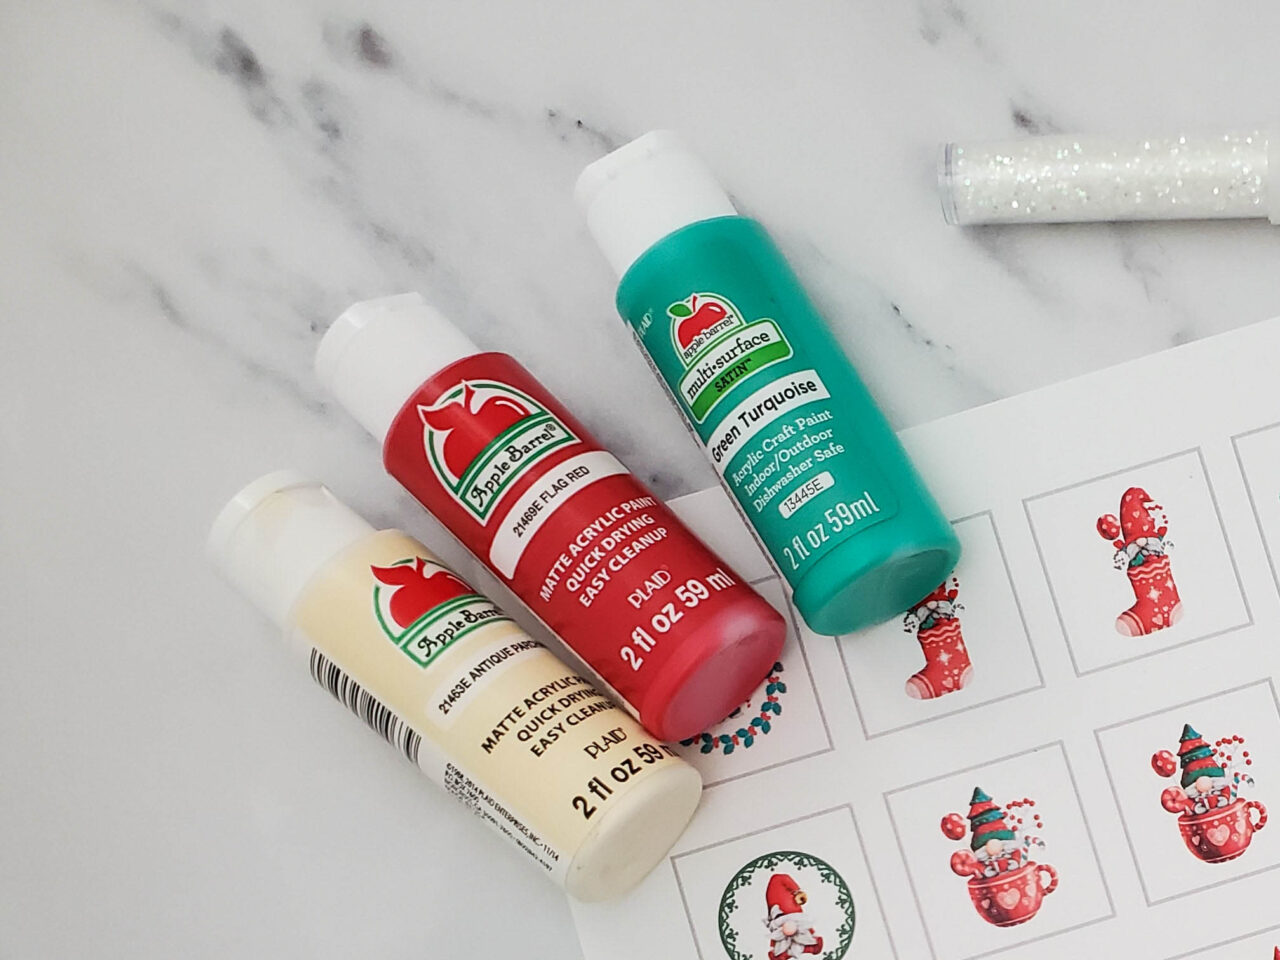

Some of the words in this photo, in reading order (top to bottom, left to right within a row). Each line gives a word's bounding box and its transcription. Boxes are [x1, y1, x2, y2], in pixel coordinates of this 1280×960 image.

[683, 337, 704, 360] apple
[703, 314, 734, 340] barrel
[712, 426, 742, 463] Green
[738, 380, 818, 429] Turquoise
[732, 447, 765, 487] Acrylic
[761, 424, 796, 452] Craft
[795, 409, 834, 431] Paint
[744, 428, 834, 497] Indoor/Outdoor
[470, 461, 511, 508] Apple
[753, 456, 814, 513] Dishwasher
[814, 442, 846, 463] Safe
[783, 477, 825, 513] 13445E
[512, 500, 544, 538] 21469E
[539, 479, 569, 505] FLAG
[565, 465, 591, 483] RED
[539, 553, 573, 602] MATTE
[567, 506, 625, 557] ACRYLIC
[620, 496, 658, 515] PAINT
[565, 546, 607, 592] QUICK
[600, 513, 656, 552] DRYING
[791, 535, 811, 561] fl
[806, 522, 830, 548] oz
[578, 569, 612, 608] EASY
[607, 527, 669, 573] CLEANUP
[783, 546, 800, 570] 2
[626, 569, 672, 609] PLAID
[673, 578, 711, 609] 59
[704, 567, 738, 592] ml
[417, 618, 466, 658] Apple
[650, 602, 685, 634] oz
[619, 645, 645, 671] 2
[631, 626, 657, 653] fl
[437, 676, 472, 715] 21463E
[470, 646, 514, 682] ANTIQUE
[480, 706, 526, 755] MATTE
[523, 676, 577, 710] ACRYLIC
[516, 704, 562, 743] QUICK
[530, 722, 567, 758] EASY
[583, 727, 629, 760] PLAID
[572, 795, 597, 820] 2
[587, 776, 614, 801] fl
[610, 757, 642, 783] oz
[634, 743, 664, 764] 59
